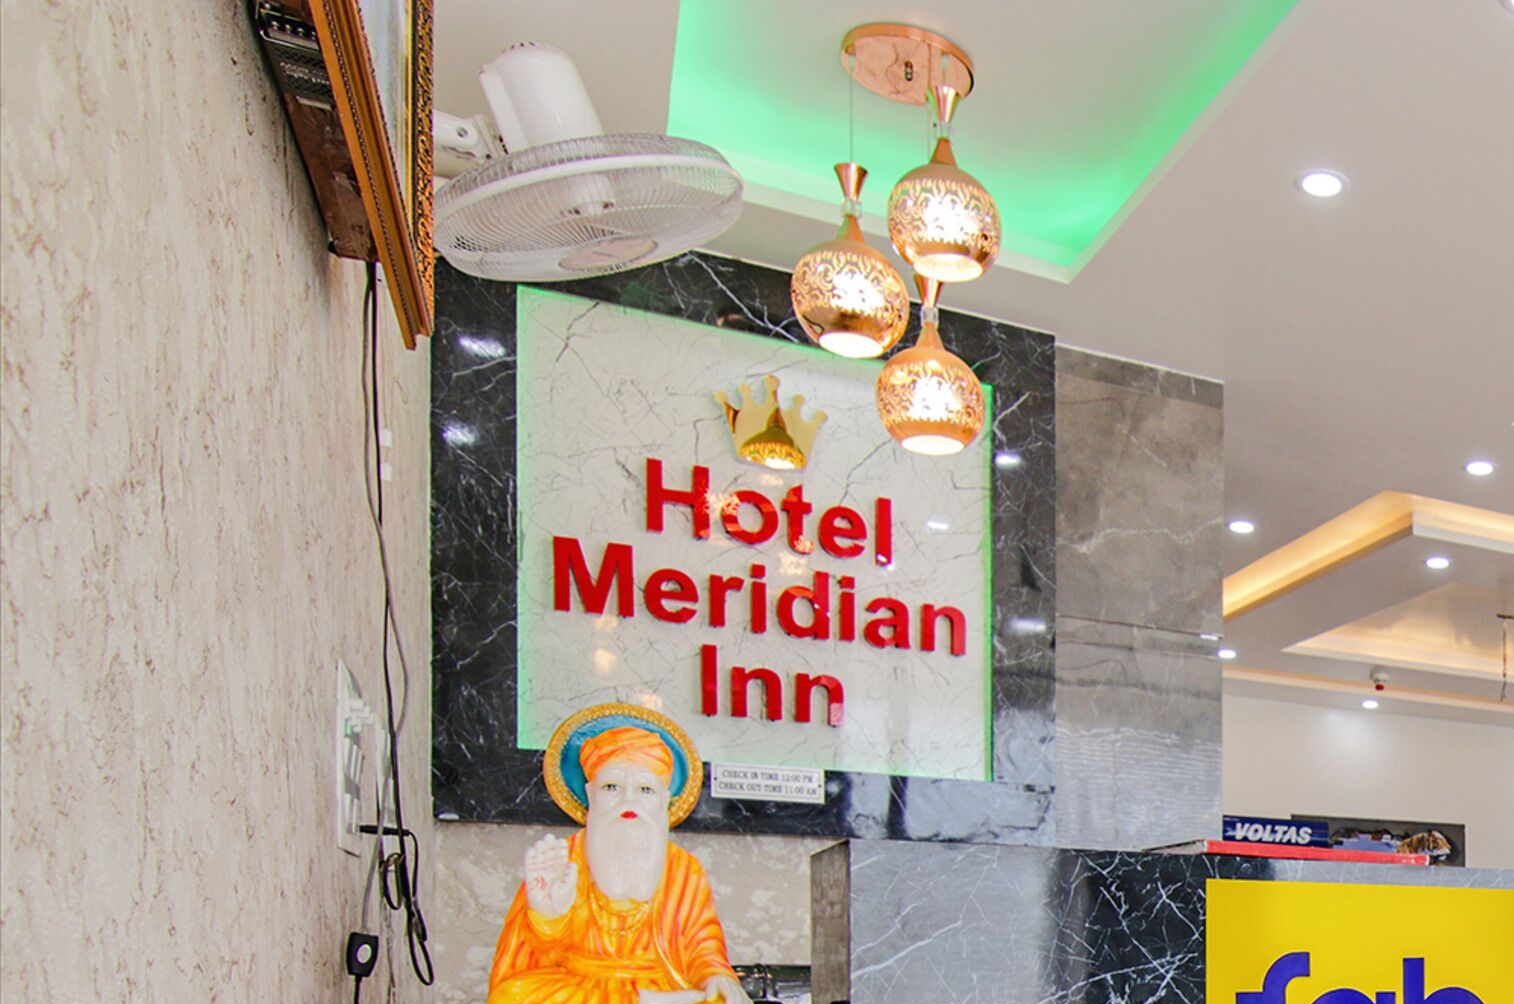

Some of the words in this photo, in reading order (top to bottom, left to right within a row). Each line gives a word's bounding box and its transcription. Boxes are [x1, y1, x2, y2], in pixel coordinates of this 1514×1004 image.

[645, 457, 893, 566] Hotel
[551, 535, 966, 657] Meridian
[700, 643, 845, 726] Inn
[718, 781, 745, 791] CHECK
[746, 782, 762, 792] OUT
[764, 783, 783, 794] TIME
[806, 786, 817, 796] AM
[722, 769, 749, 779] CHECK
[751, 770, 759, 780] IN
[761, 771, 779, 781] TIME
[803, 774, 814, 784] PM
[1234, 821, 1313, 845] VOLTAS
